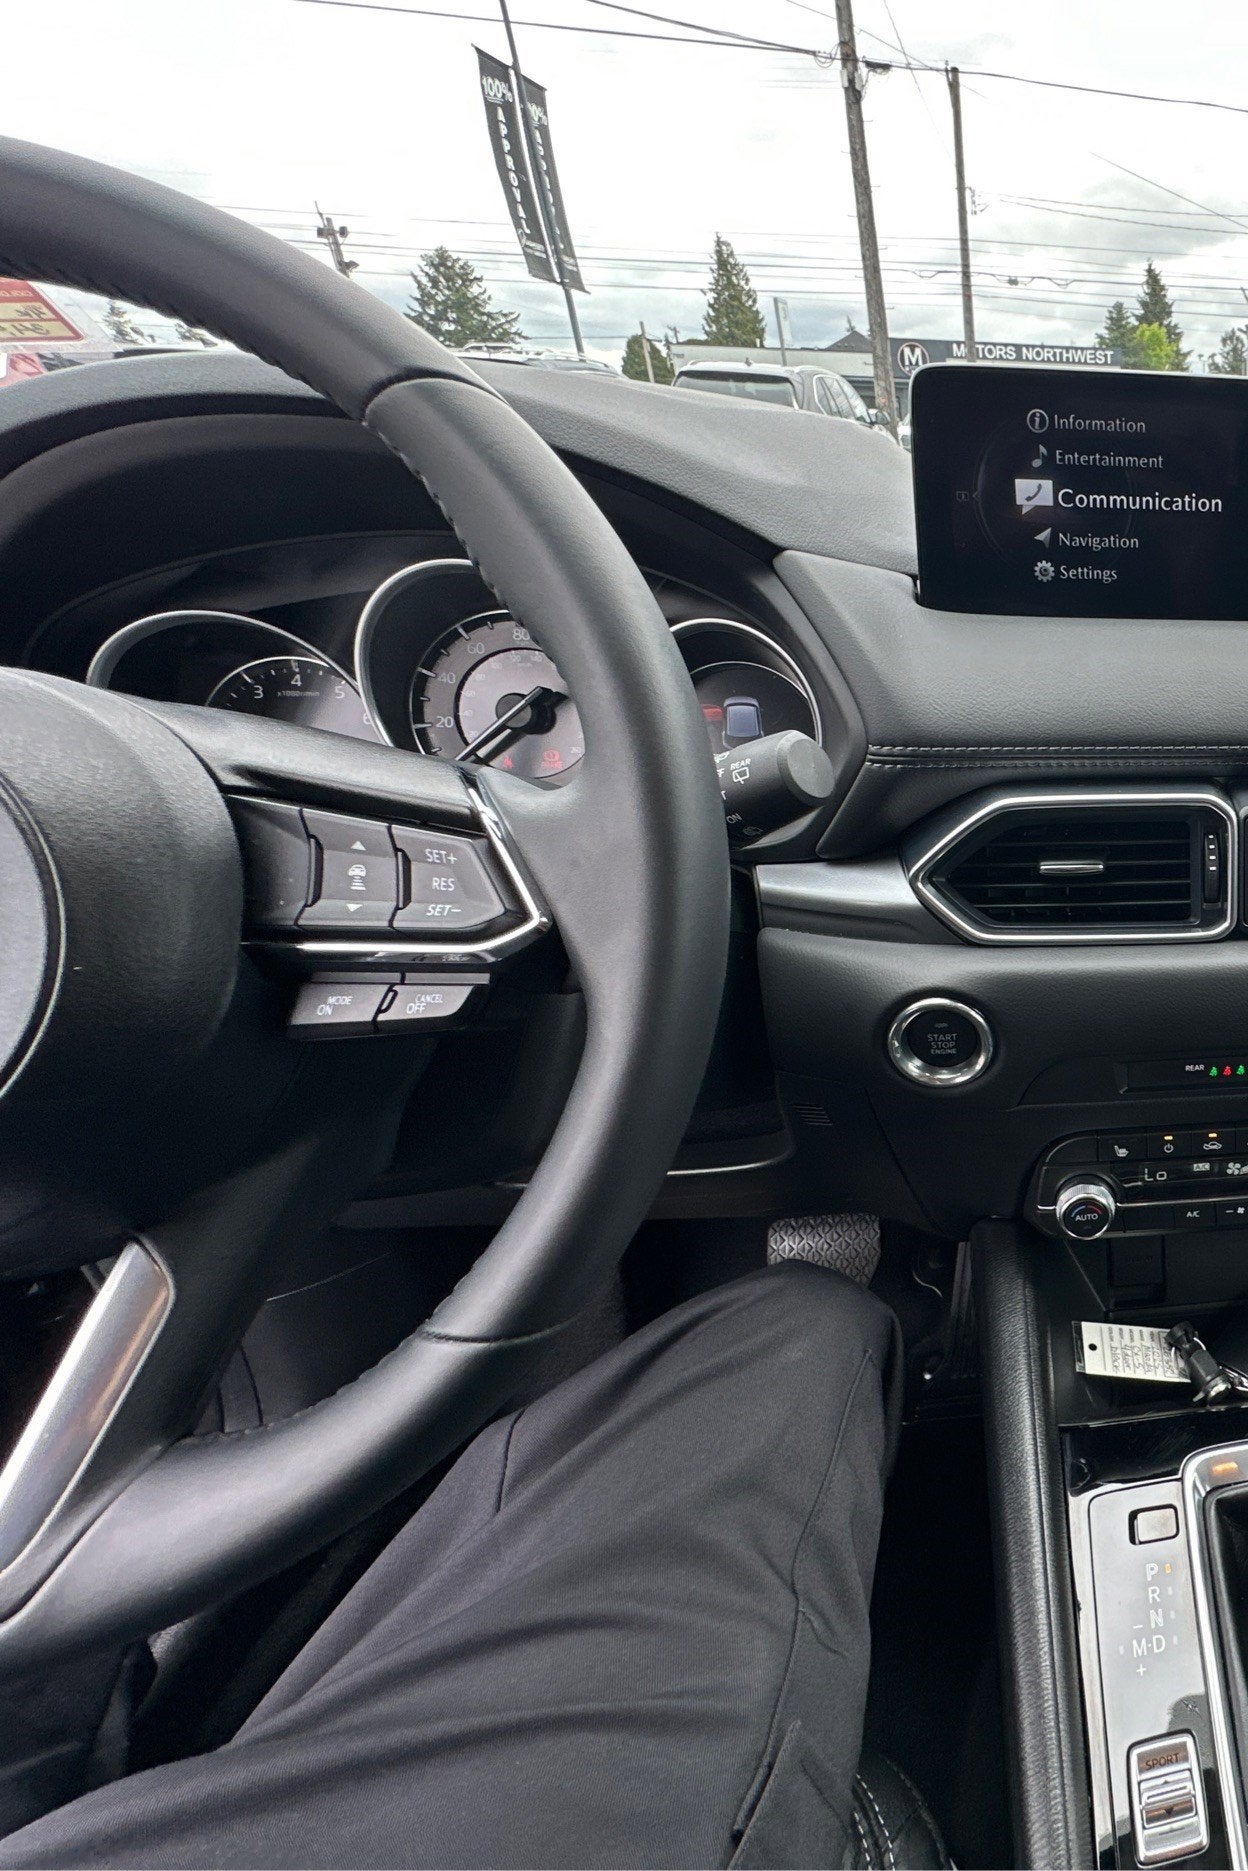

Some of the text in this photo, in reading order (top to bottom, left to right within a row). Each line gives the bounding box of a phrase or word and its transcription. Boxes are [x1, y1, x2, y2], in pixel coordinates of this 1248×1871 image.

[482, 76, 512, 102] 100%
[497, 106, 530, 234] APPROVAL
[952, 343, 1114, 365] MTORS NORTHWEST
[1054, 414, 1146, 433] Information
[1055, 450, 1163, 469] Entertainment
[1058, 488, 1222, 512] Communication
[1059, 533, 1139, 551] Navigation
[1060, 565, 1118, 584] Settings
[512, 628, 530, 641] 80
[467, 642, 485, 654] 60
[290, 674, 302, 687] 4
[437, 672, 456, 684] 40
[253, 685, 264, 699] 3
[335, 686, 345, 699] 5
[436, 716, 454, 728] 20
[730, 758, 751, 770] REAR
[726, 813, 742, 823] ON
[425, 848, 458, 865] SET+
[431, 877, 455, 891] RES
[327, 996, 353, 1005] MODE
[415, 994, 443, 1004] CANCEL
[317, 1004, 333, 1016] ON
[406, 1003, 427, 1014] OFF
[927, 1033, 958, 1041] START
[931, 1041, 956, 1049] STOP
[1185, 1064, 1205, 1072] REAR
[1075, 1213, 1098, 1221] AUTO
[1186, 1210, 1200, 1218] A/C
[1146, 1563, 1158, 1581] P
[1148, 1586, 1160, 1603] R
[1150, 1609, 1164, 1629] N
[1145, 1752, 1180, 1771] SPORT
